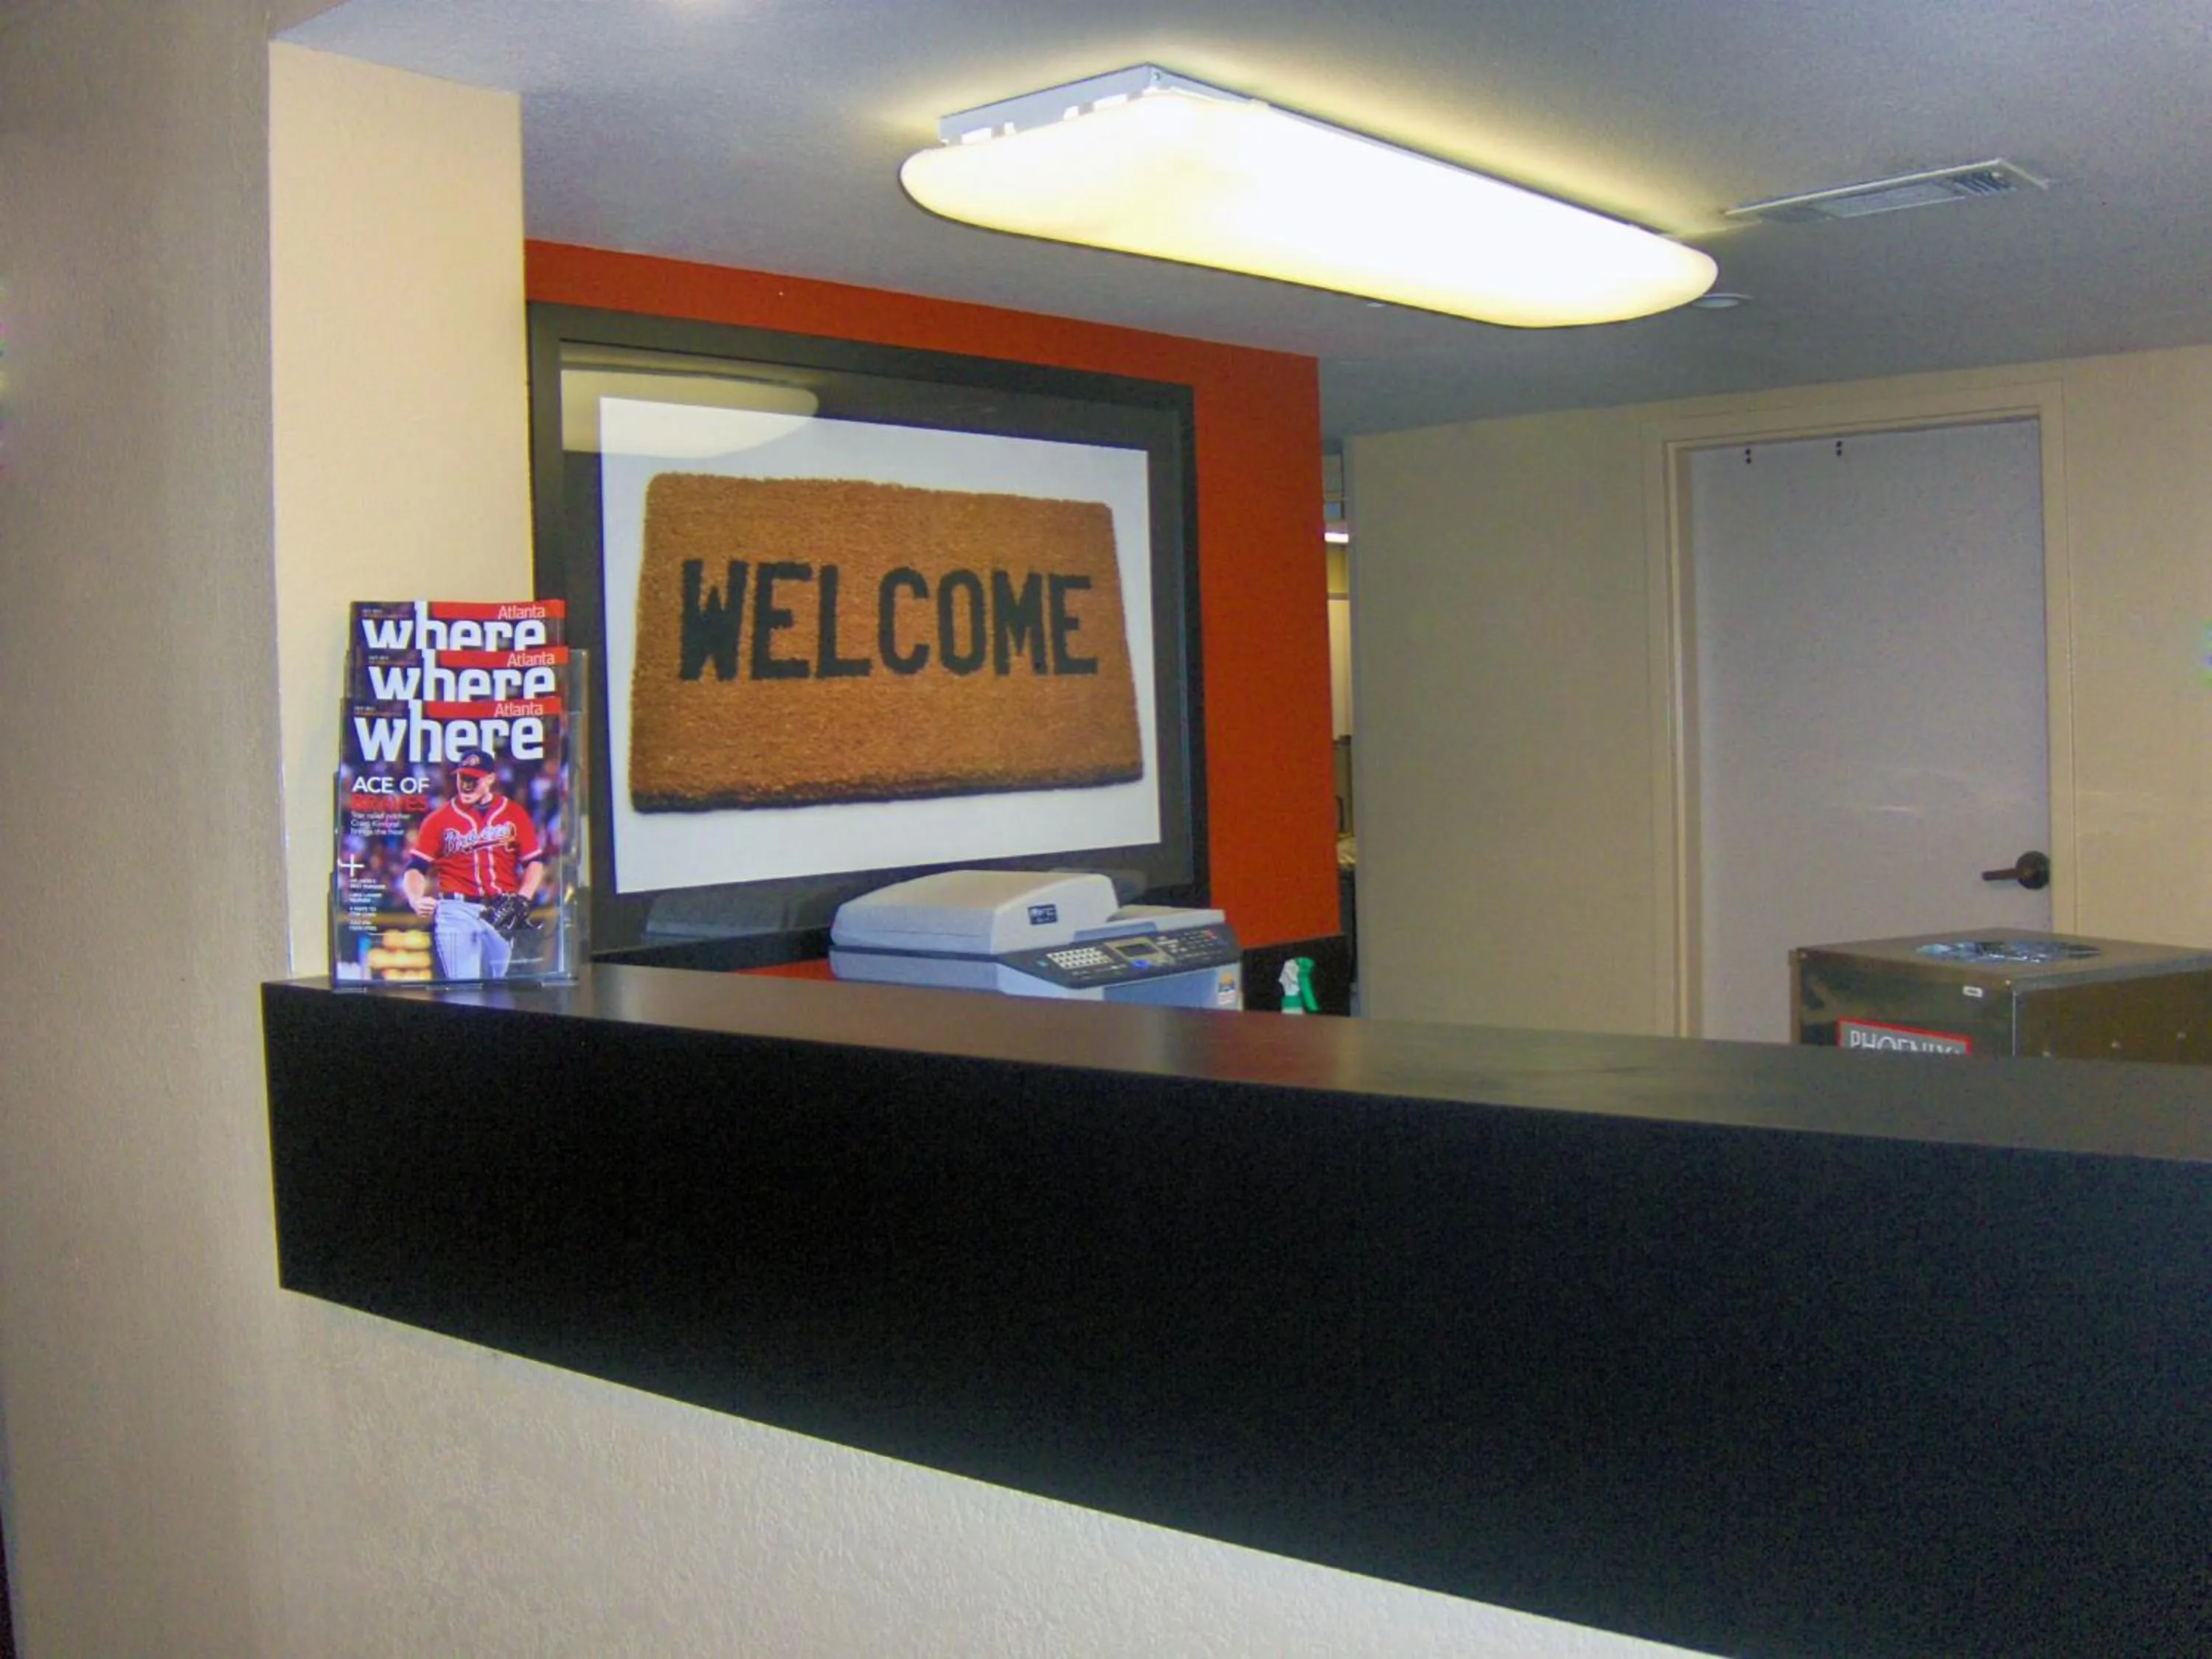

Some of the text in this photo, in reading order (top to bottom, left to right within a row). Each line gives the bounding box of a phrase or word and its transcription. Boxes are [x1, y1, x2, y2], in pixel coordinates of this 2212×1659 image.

[362, 601, 547, 652] where
[497, 605, 546, 620] Atlanta
[678, 558, 1099, 681] WELCOME
[368, 649, 556, 702] where
[507, 652, 555, 667] Atlanta
[493, 702, 544, 717] Atlanta
[354, 700, 544, 762] where
[352, 776, 431, 794] ACE OF
